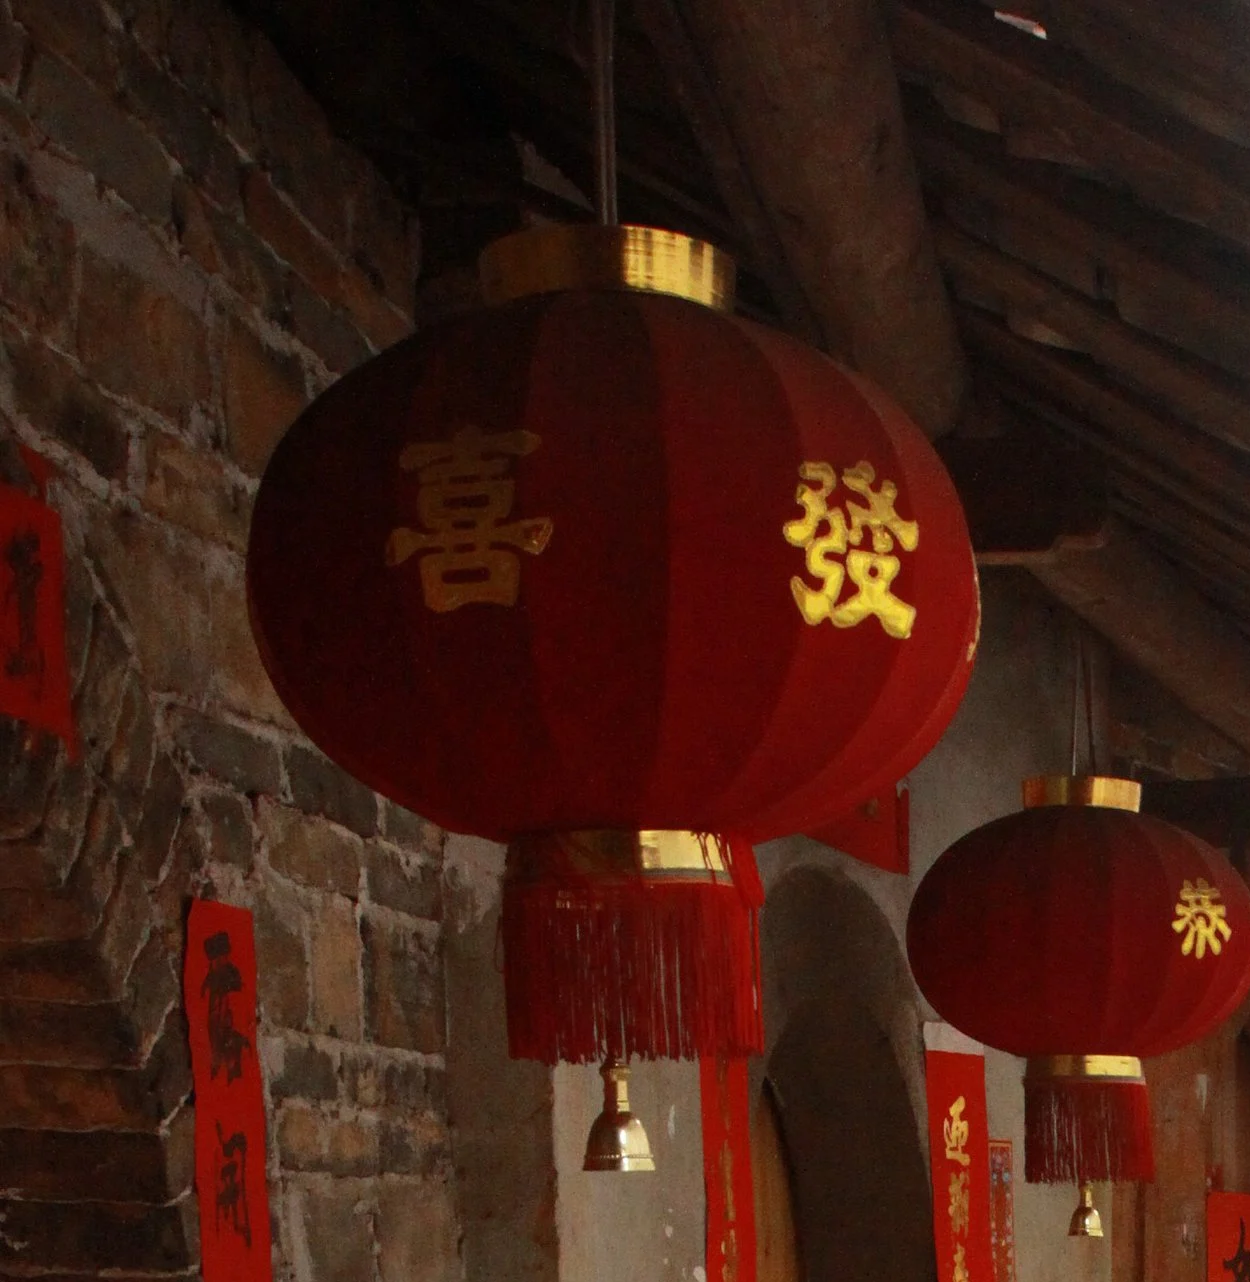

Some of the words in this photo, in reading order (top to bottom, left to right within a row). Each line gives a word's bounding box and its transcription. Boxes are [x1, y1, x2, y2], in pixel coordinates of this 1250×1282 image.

[385, 426, 554, 613] 喜
[783, 460, 920, 640] 發
[1171, 878, 1232, 959] 恭
